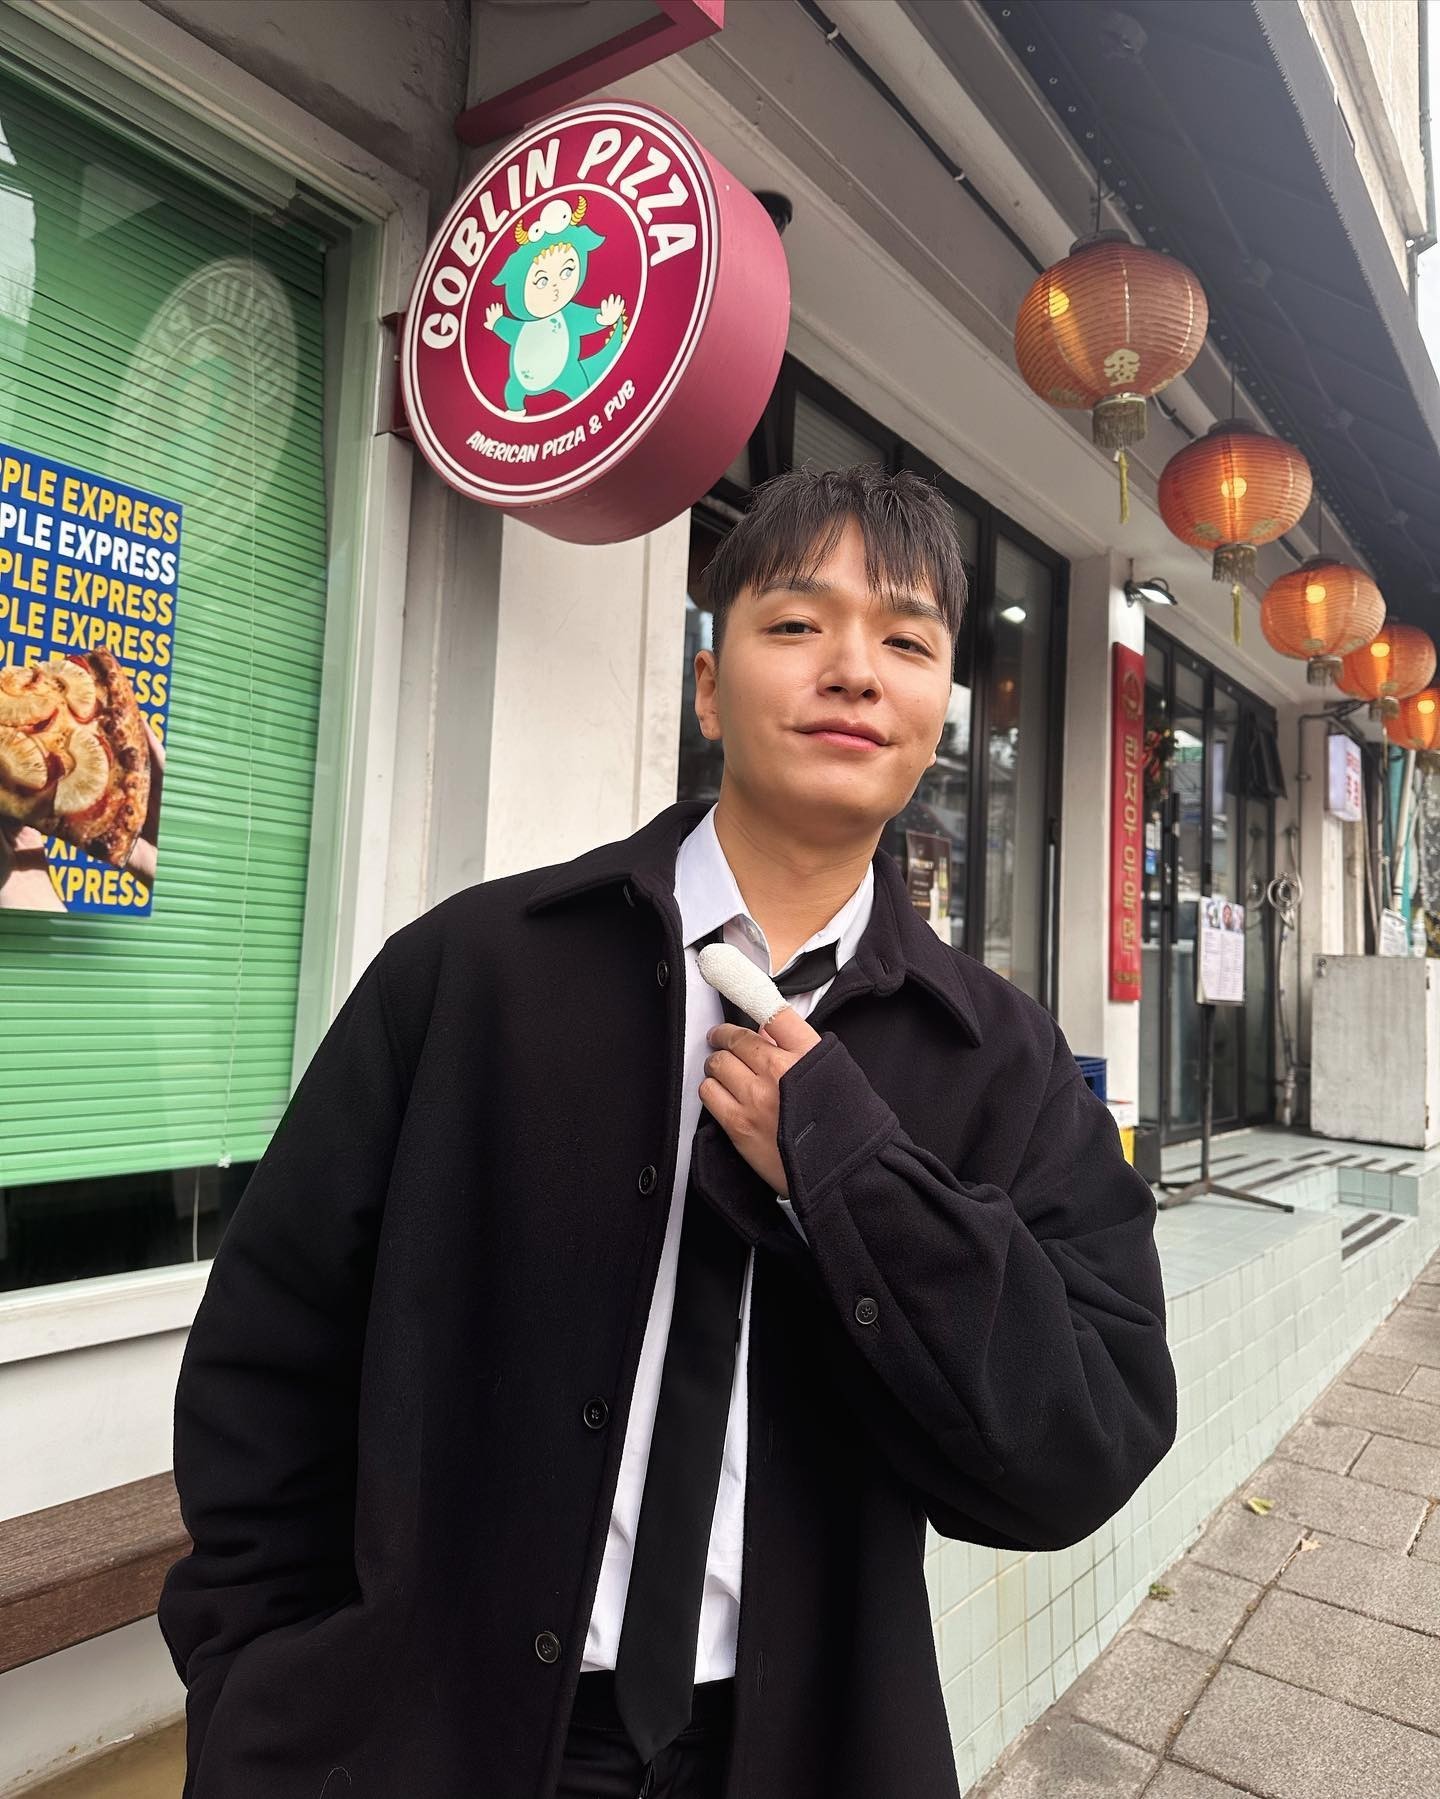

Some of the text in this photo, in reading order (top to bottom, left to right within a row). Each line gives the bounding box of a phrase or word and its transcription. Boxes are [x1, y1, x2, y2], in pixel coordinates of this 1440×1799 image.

[421, 138, 560, 349] GOBLIN
[577, 128, 697, 267] PIZZA
[466, 379, 636, 463] AMERICAN PIZZA & PUB
[0, 457, 179, 545] PLE EXPRESS
[0, 502, 177, 585] PLE EXPRESS
[54, 564, 174, 626] EXPRESS
[51, 607, 172, 667] EXPRESS
[48, 865, 150, 908] XPRESS
